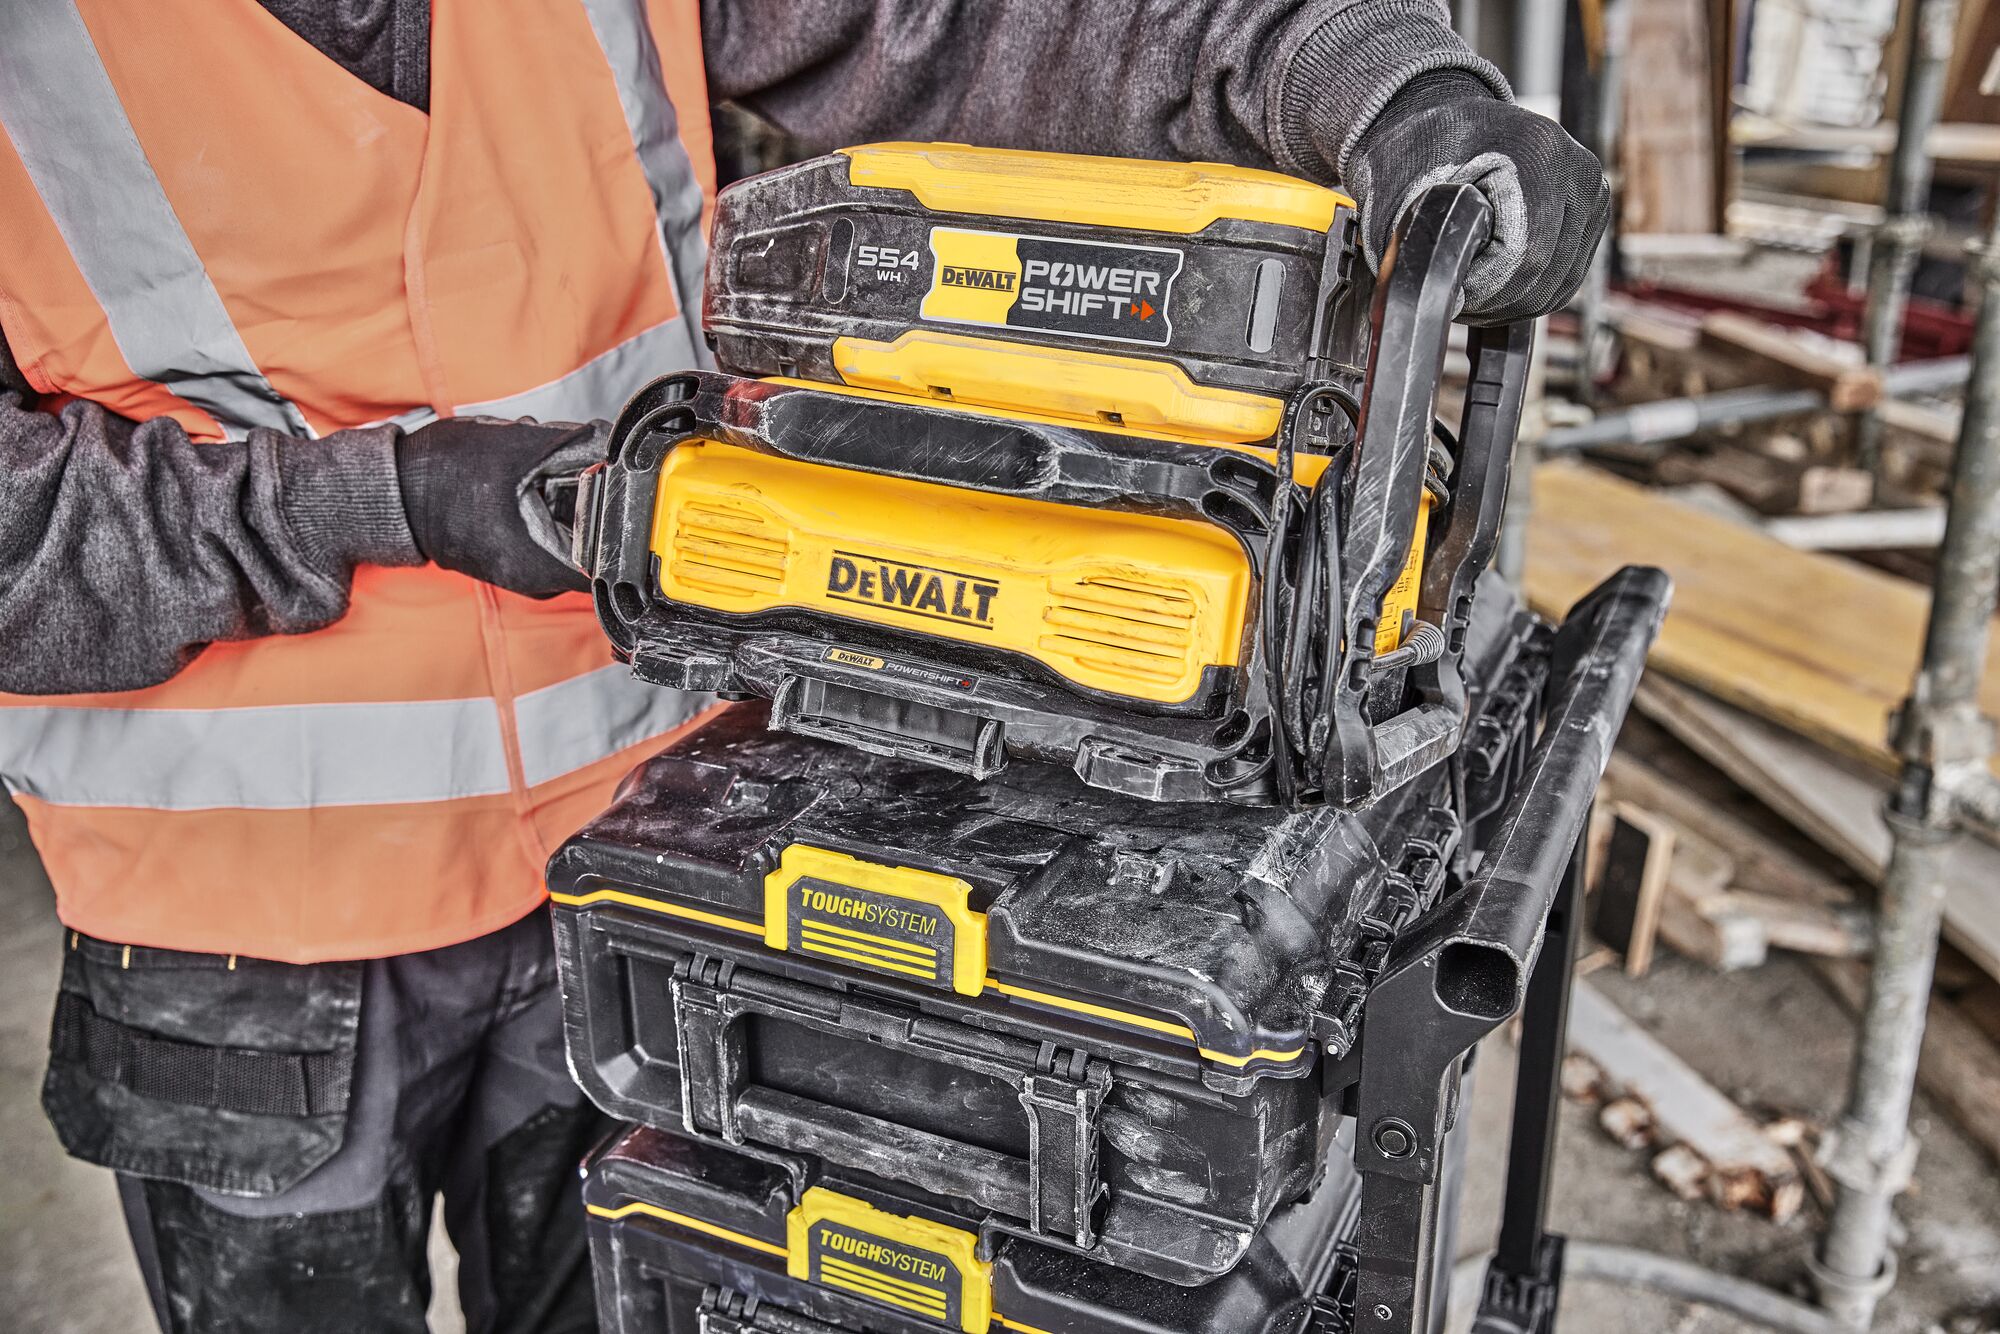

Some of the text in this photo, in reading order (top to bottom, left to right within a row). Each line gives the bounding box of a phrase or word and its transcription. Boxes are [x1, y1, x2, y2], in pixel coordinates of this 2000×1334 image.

[857, 245, 919, 271] 554
[876, 270, 901, 283] WH
[1024, 259, 1161, 296] POWER
[1021, 287, 1131, 320] SHIFT
[886, 662, 963, 686] POWERSHIFT
[801, 887, 937, 936] TOUGHSYSTEM
[820, 1229, 947, 1282] TOUGHSYSTEM
